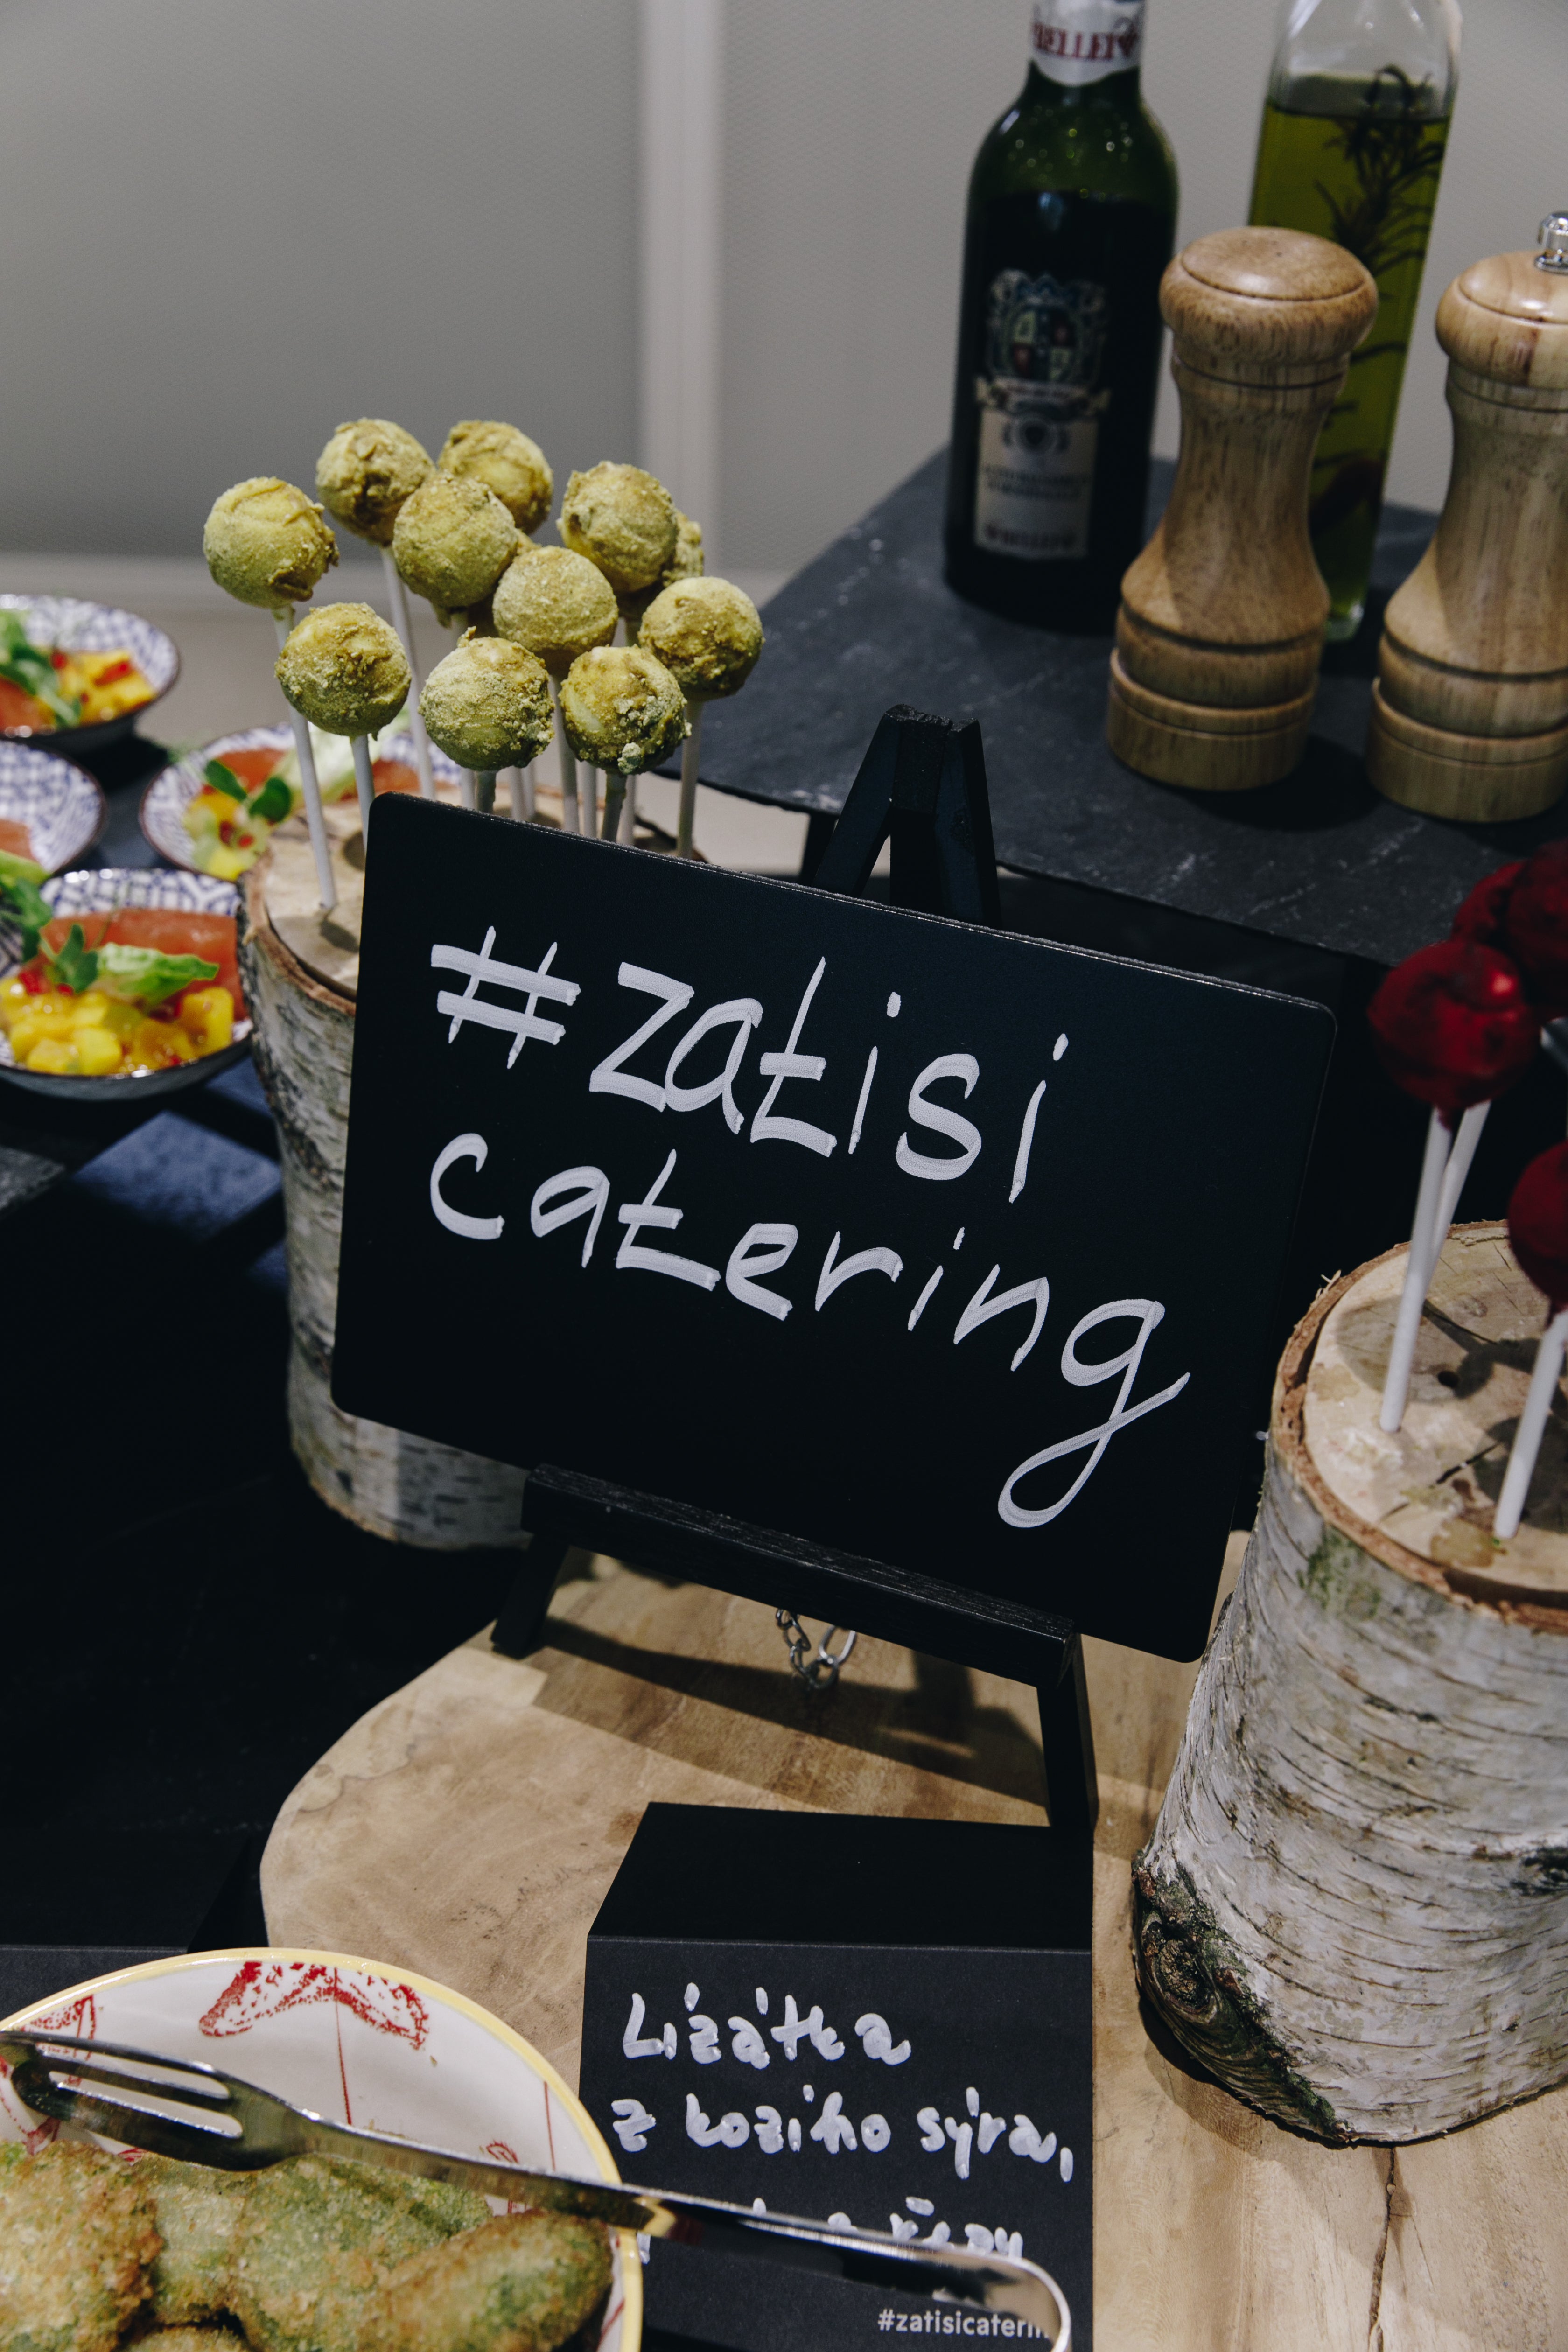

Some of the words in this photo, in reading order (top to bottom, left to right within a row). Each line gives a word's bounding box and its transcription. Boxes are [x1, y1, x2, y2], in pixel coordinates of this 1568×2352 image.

[430, 925, 1069, 1204] #zatisi
[430, 1133, 1191, 1528] catering
[610, 2098, 657, 2152] z
